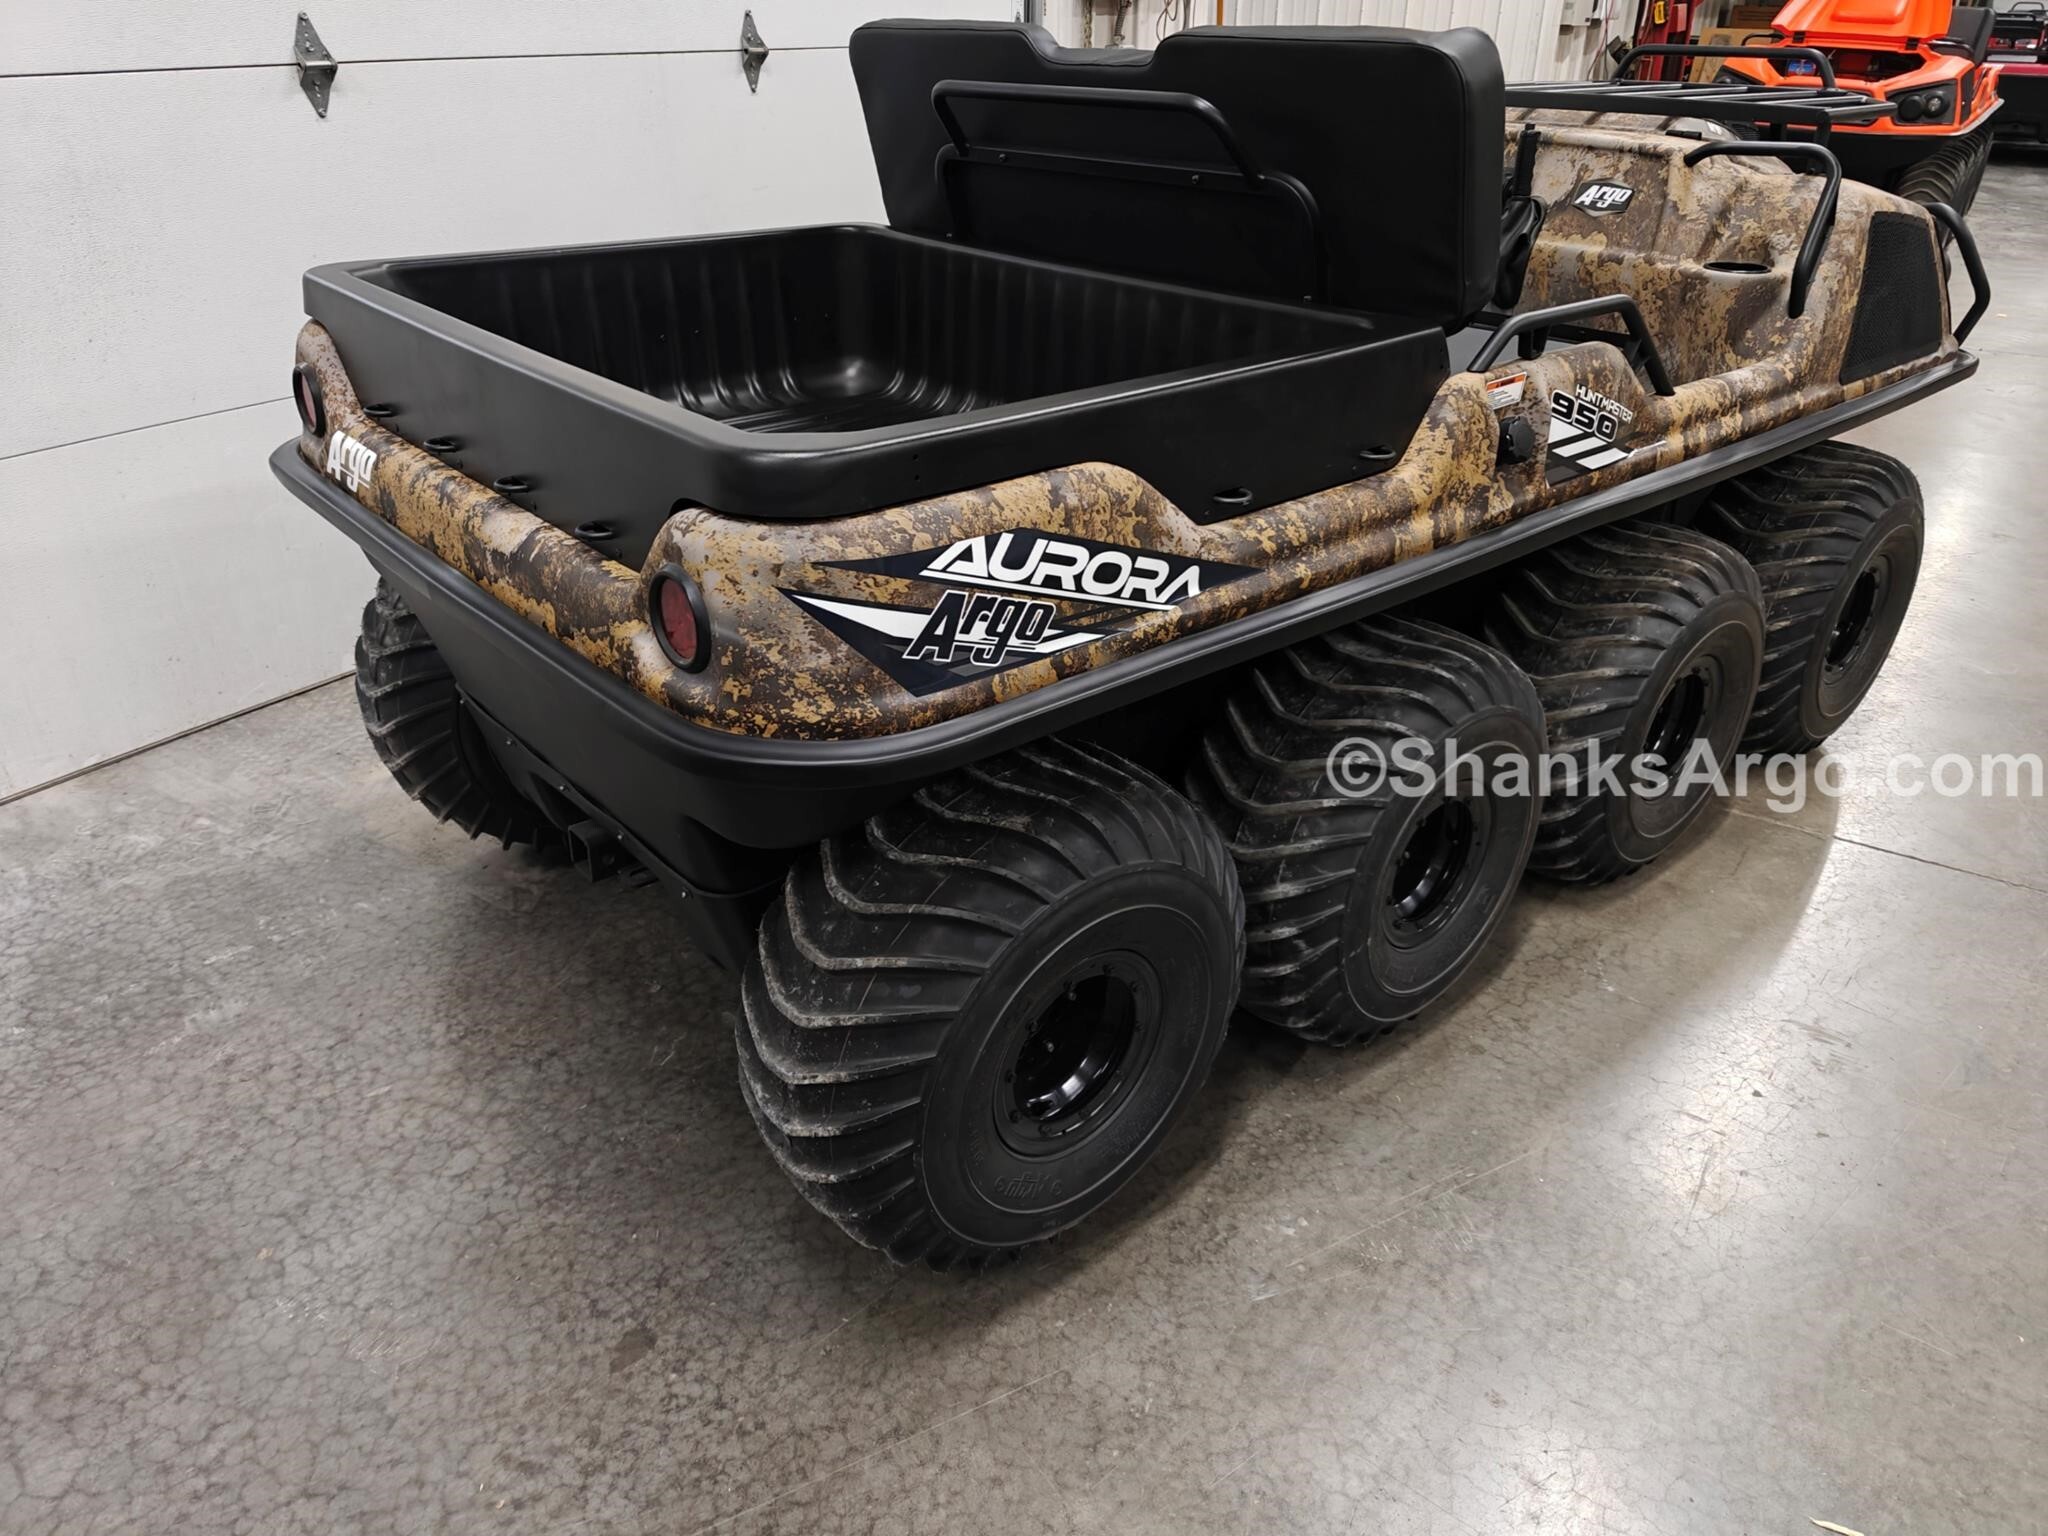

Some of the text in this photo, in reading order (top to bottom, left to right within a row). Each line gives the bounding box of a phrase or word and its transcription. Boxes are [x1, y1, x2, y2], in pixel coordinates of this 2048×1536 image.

[1574, 184, 1633, 208] Argo
[1552, 390, 1618, 442] 950
[1575, 384, 1633, 424] HUNTMASTER
[326, 430, 377, 492] Argo
[926, 532, 1201, 603] AURORA
[902, 589, 1056, 667] Argo
